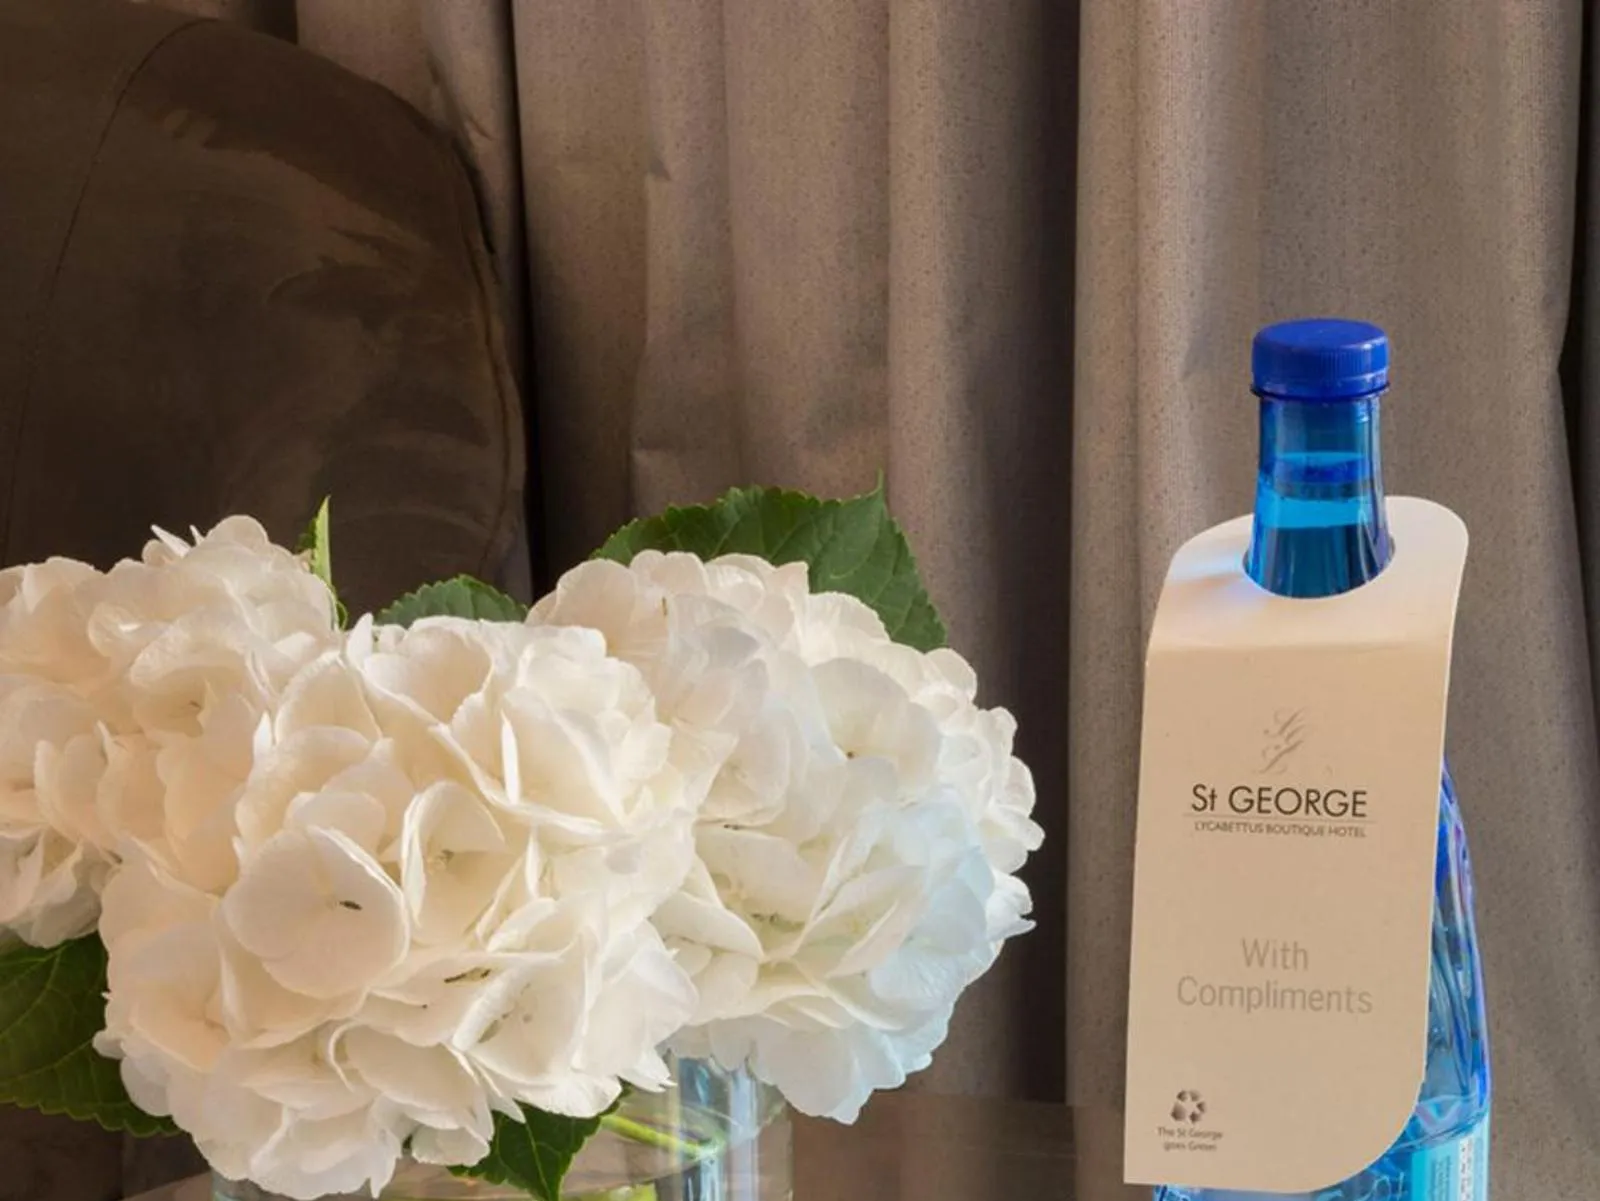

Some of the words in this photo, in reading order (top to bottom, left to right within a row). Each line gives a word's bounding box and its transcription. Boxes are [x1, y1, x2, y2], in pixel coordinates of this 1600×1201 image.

[1190, 783, 1218, 812] St
[1227, 785, 1368, 818] GEORGE
[1194, 820, 1265, 834] LYCABETTUS
[1266, 822, 1325, 838] BOUTIQUE
[1328, 825, 1367, 839] HOTEL
[1241, 937, 1310, 972] With
[1176, 975, 1374, 1016] Compliments
